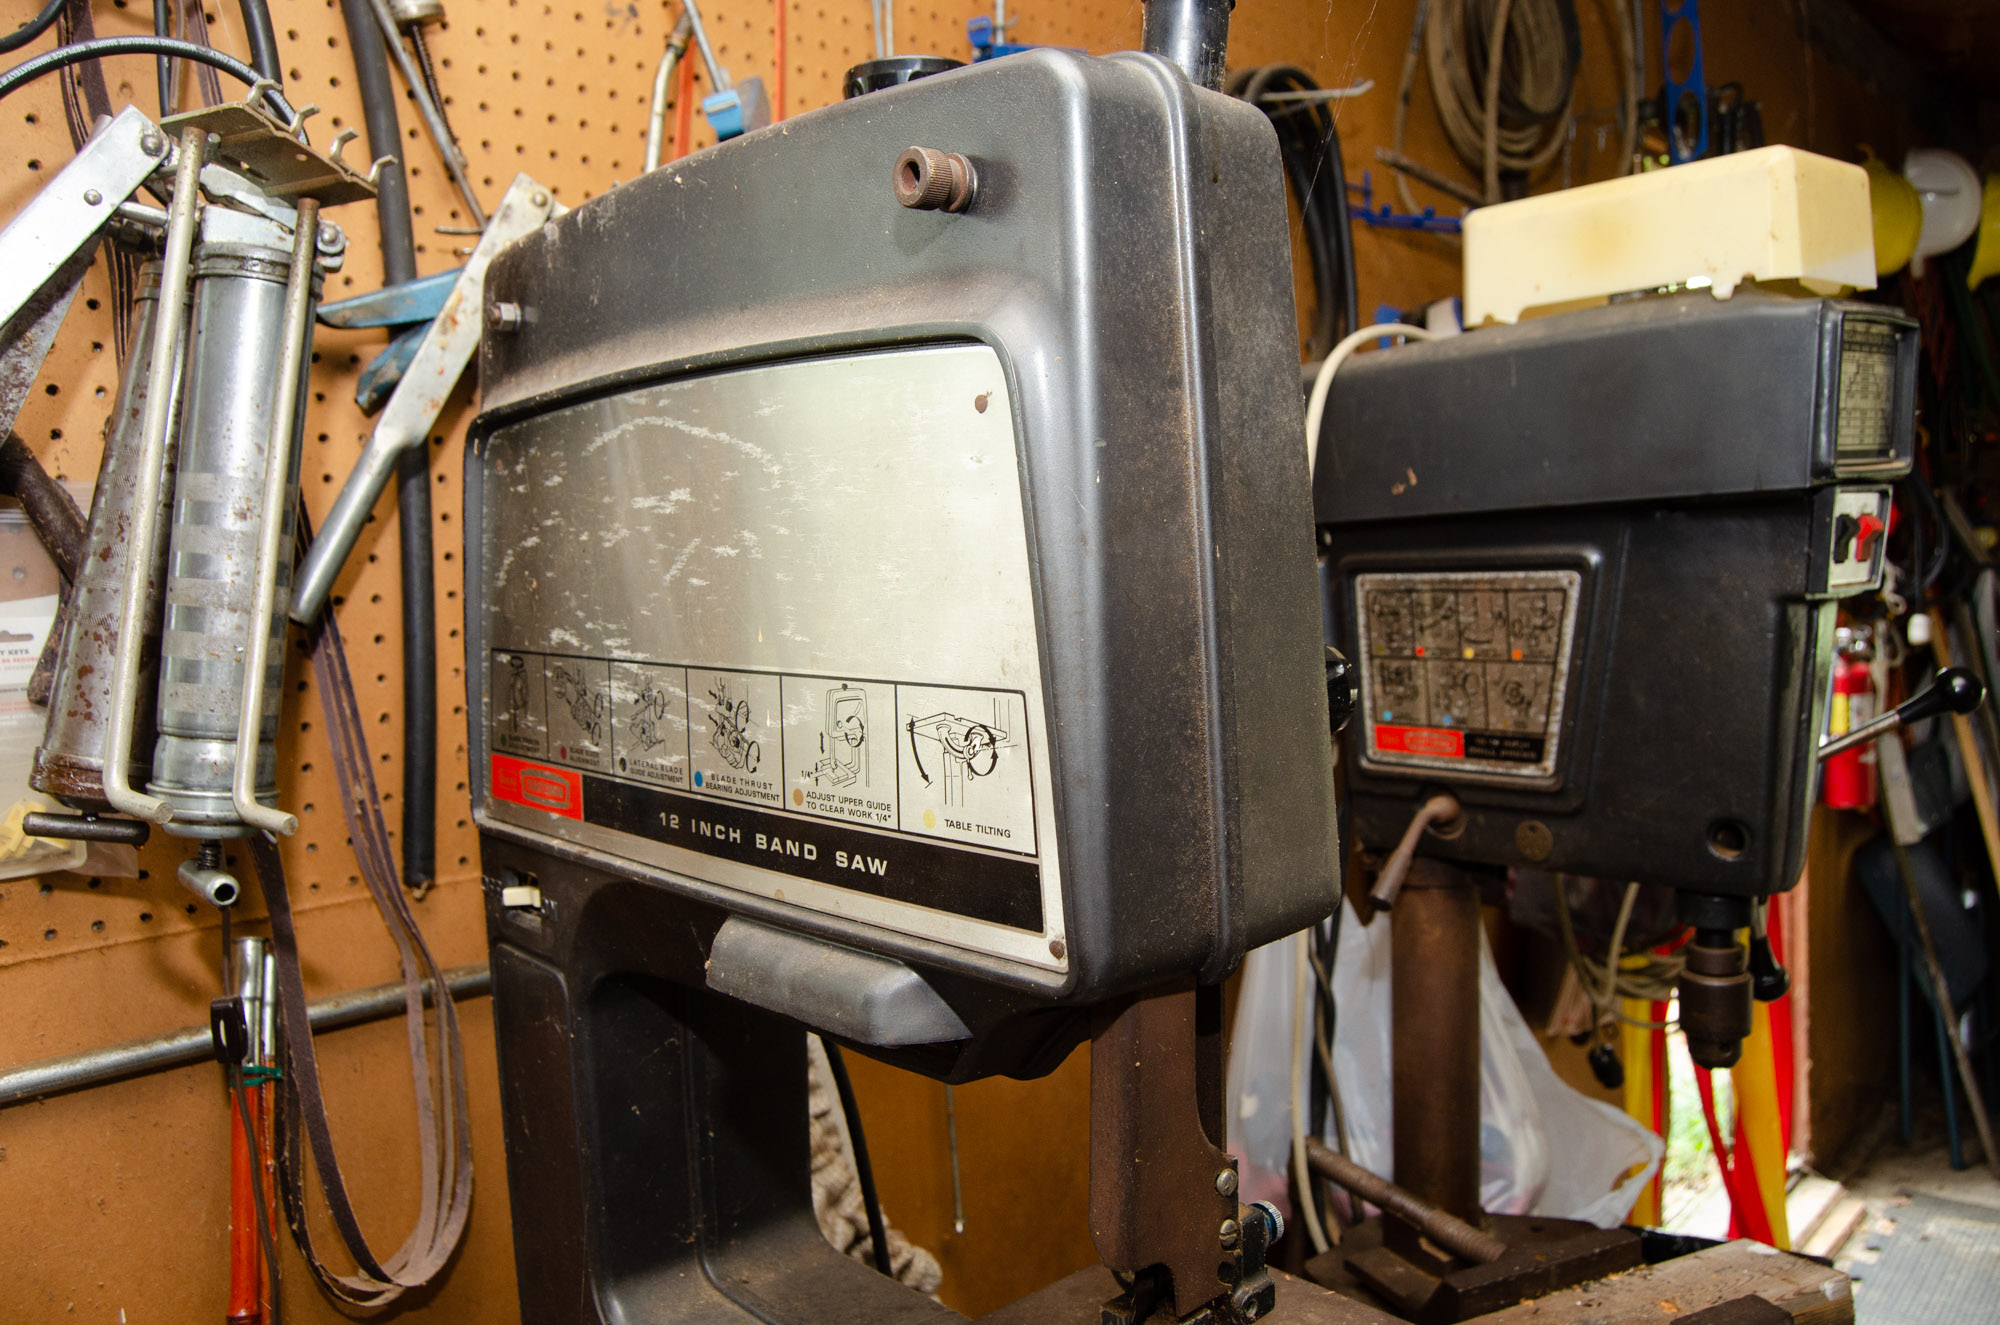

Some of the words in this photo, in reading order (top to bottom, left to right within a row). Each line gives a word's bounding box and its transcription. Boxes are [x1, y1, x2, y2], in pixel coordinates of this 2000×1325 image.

[118, 37, 159, 46] PRESSURE
[52, 44, 86, 60] REPLACE
[6, 54, 52, 82] IMMEDIATELY
[8, 648, 29, 656] KEYS
[630, 759, 660, 771] LATERAL
[661, 765, 684, 776] BLADE
[630, 767, 647, 777] GUIDE
[647, 771, 685, 784] ADJUSTMENT
[711, 774, 737, 785] BLADE
[740, 779, 773, 791] THRUST
[705, 782, 734, 793] BEARING
[735, 788, 780, 802] ADJUSTMENT
[806, 790, 837, 804] ADJUST
[838, 796, 864, 808] UPPER
[866, 800, 893, 813] GUIDE
[806, 800, 818, 811] TO
[819, 803, 846, 816] CLEAR
[847, 808, 874, 821] WORK
[944, 819, 973, 832] TABLE
[976, 825, 1011, 838] TILTING
[659, 811, 680, 830] 12
[691, 818, 741, 844] INCH
[756, 833, 817, 861] BAND
[834, 850, 889, 877] SAW
